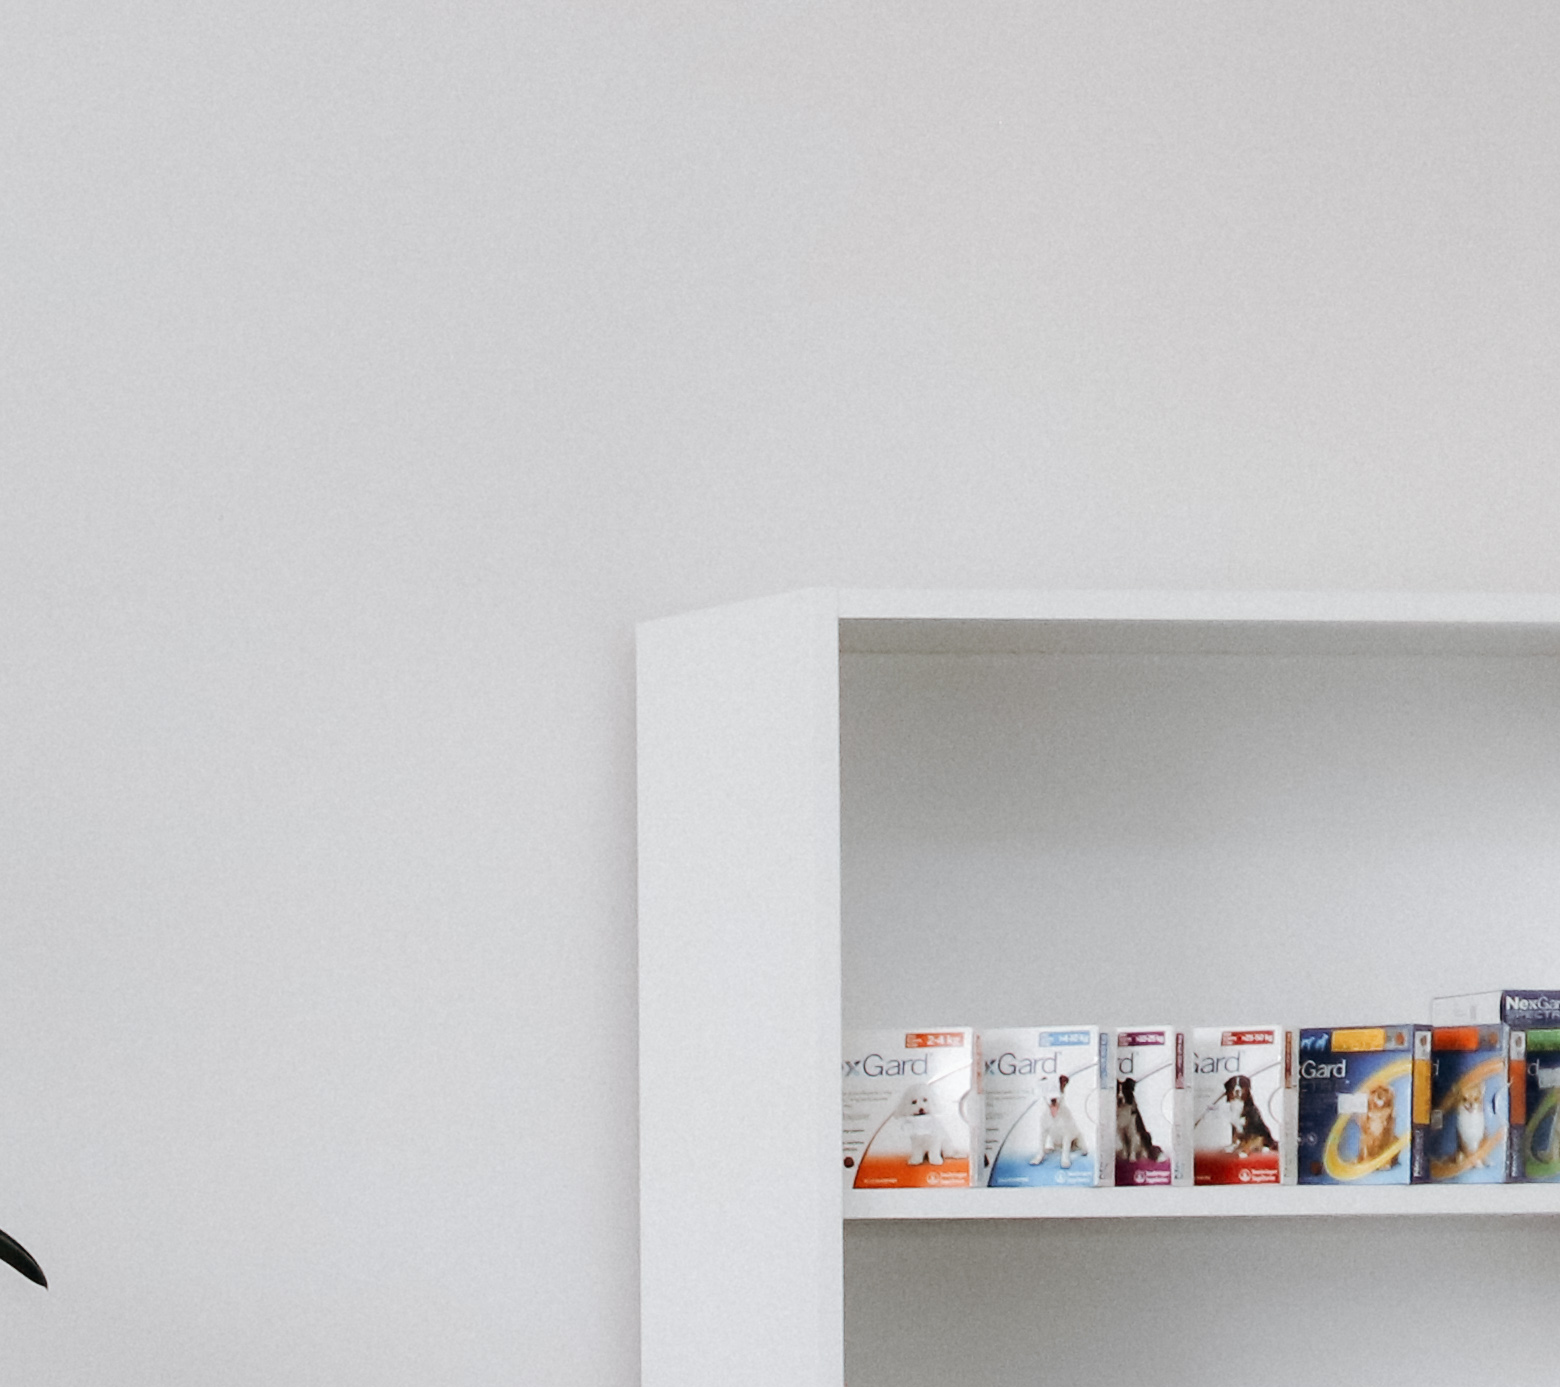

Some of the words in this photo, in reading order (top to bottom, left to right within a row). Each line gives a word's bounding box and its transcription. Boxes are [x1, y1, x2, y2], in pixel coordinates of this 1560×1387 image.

[1506, 996, 1560, 1010] NexGar
[845, 1053, 929, 1077] xGard
[1301, 1059, 1346, 1078] Gard
